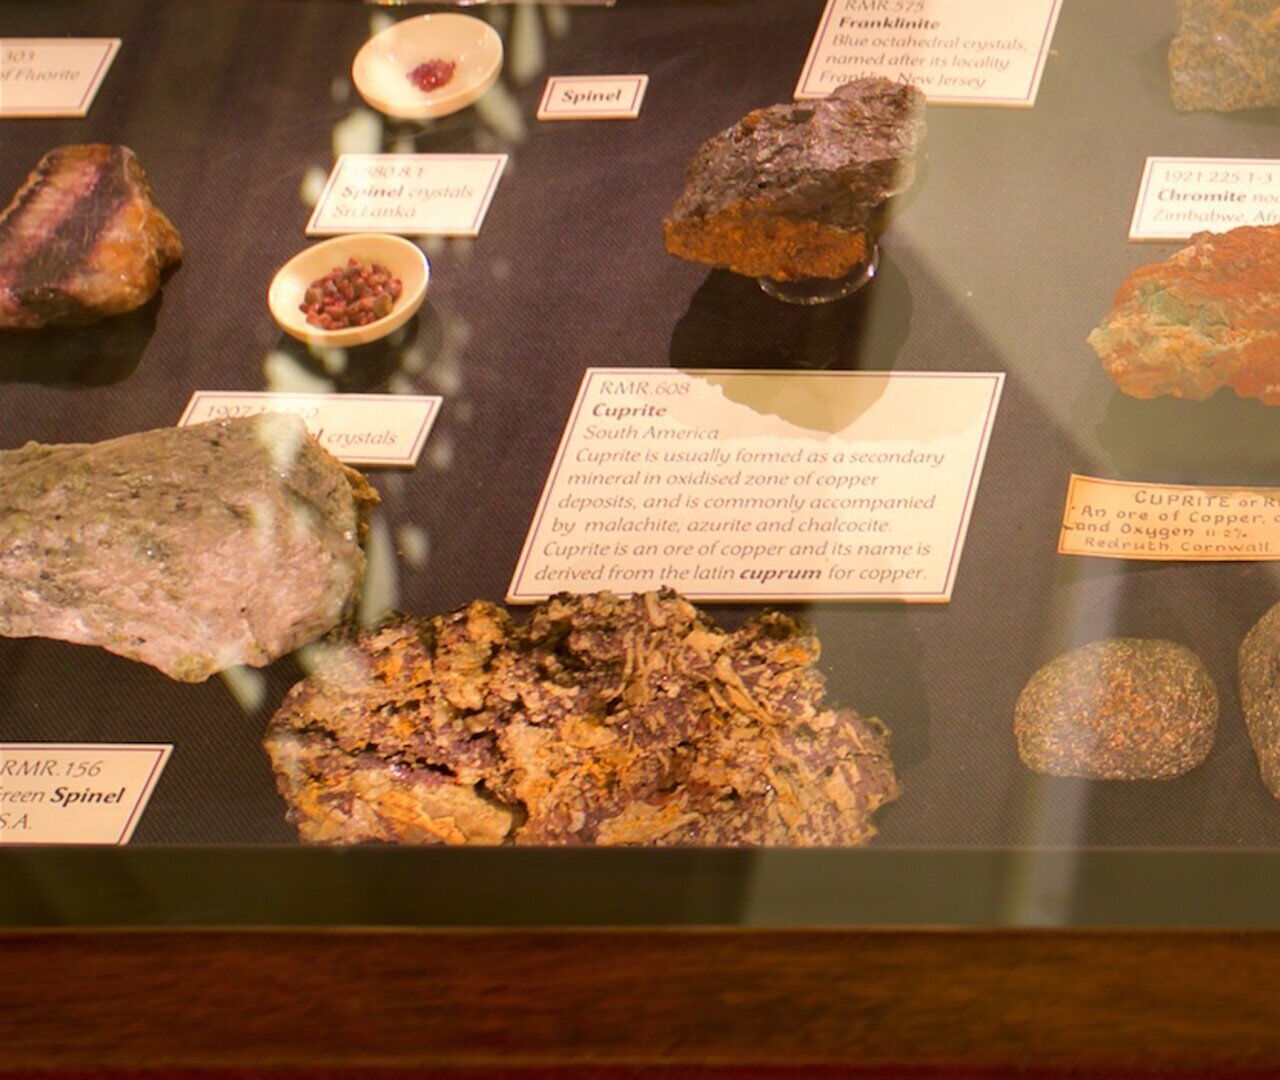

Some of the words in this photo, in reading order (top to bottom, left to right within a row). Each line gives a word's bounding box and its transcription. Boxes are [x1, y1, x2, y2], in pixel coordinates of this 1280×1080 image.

[839, 17, 940, 30] Franklinite
[832, 34, 869, 48] Blue
[872, 34, 959, 49] octahedral
[963, 37, 1028, 52] crystals,
[826, 54, 884, 66] named
[888, 54, 926, 67] after
[952, 55, 1010, 70] locality
[897, 73, 933, 85] New
[938, 74, 986, 89] Jersey
[562, 89, 622, 105] Spinel
[342, 185, 405, 200] Spinel
[408, 185, 474, 201] crystals
[1158, 188, 1247, 203] Chromite
[361, 204, 416, 218] Lanka
[592, 403, 667, 420] Cuprite
[327, 430, 398, 448] crystals
[583, 425, 638, 440] South
[642, 426, 719, 440] America
[576, 447, 642, 465] Cuprite
[664, 448, 731, 467] usually
[735, 448, 803, 464] formed
[850, 450, 945, 468] secondary
[568, 471, 641, 485] mineral
[666, 472, 741, 486] oxidised
[744, 473, 789, 486] zone
[816, 475, 879, 489] copper
[558, 494, 637, 511] deposits,
[643, 494, 682, 509] and
[704, 495, 805, 513] commonly
[809, 495, 936, 510] accompanied
[1135, 490, 1230, 508] CUPRITE
[1080, 506, 1107, 518] An
[1117, 510, 1149, 521] ore
[552, 517, 576, 537] by
[585, 517, 680, 533] malachite,
[687, 519, 752, 532] azurite
[756, 517, 794, 532] and
[798, 517, 893, 532] chalcocite.
[1121, 523, 1195, 539] Oxygen
[543, 541, 610, 560] Cuprite
[698, 541, 719, 556] of
[721, 543, 785, 560] copper
[789, 541, 828, 556] and
[832, 542, 852, 556] its
[858, 544, 912, 556] name
[916, 542, 931, 556] is
[534, 564, 604, 581] derived
[608, 565, 654, 580] from
[660, 565, 689, 580] the
[693, 565, 735, 580] latin
[740, 568, 822, 584] cuprum
[828, 564, 854, 580] for
[859, 568, 928, 584] copper.
[1, 760, 104, 777] RMR.156
[0, 787, 45, 803] reen
[50, 787, 126, 807] Spinel
